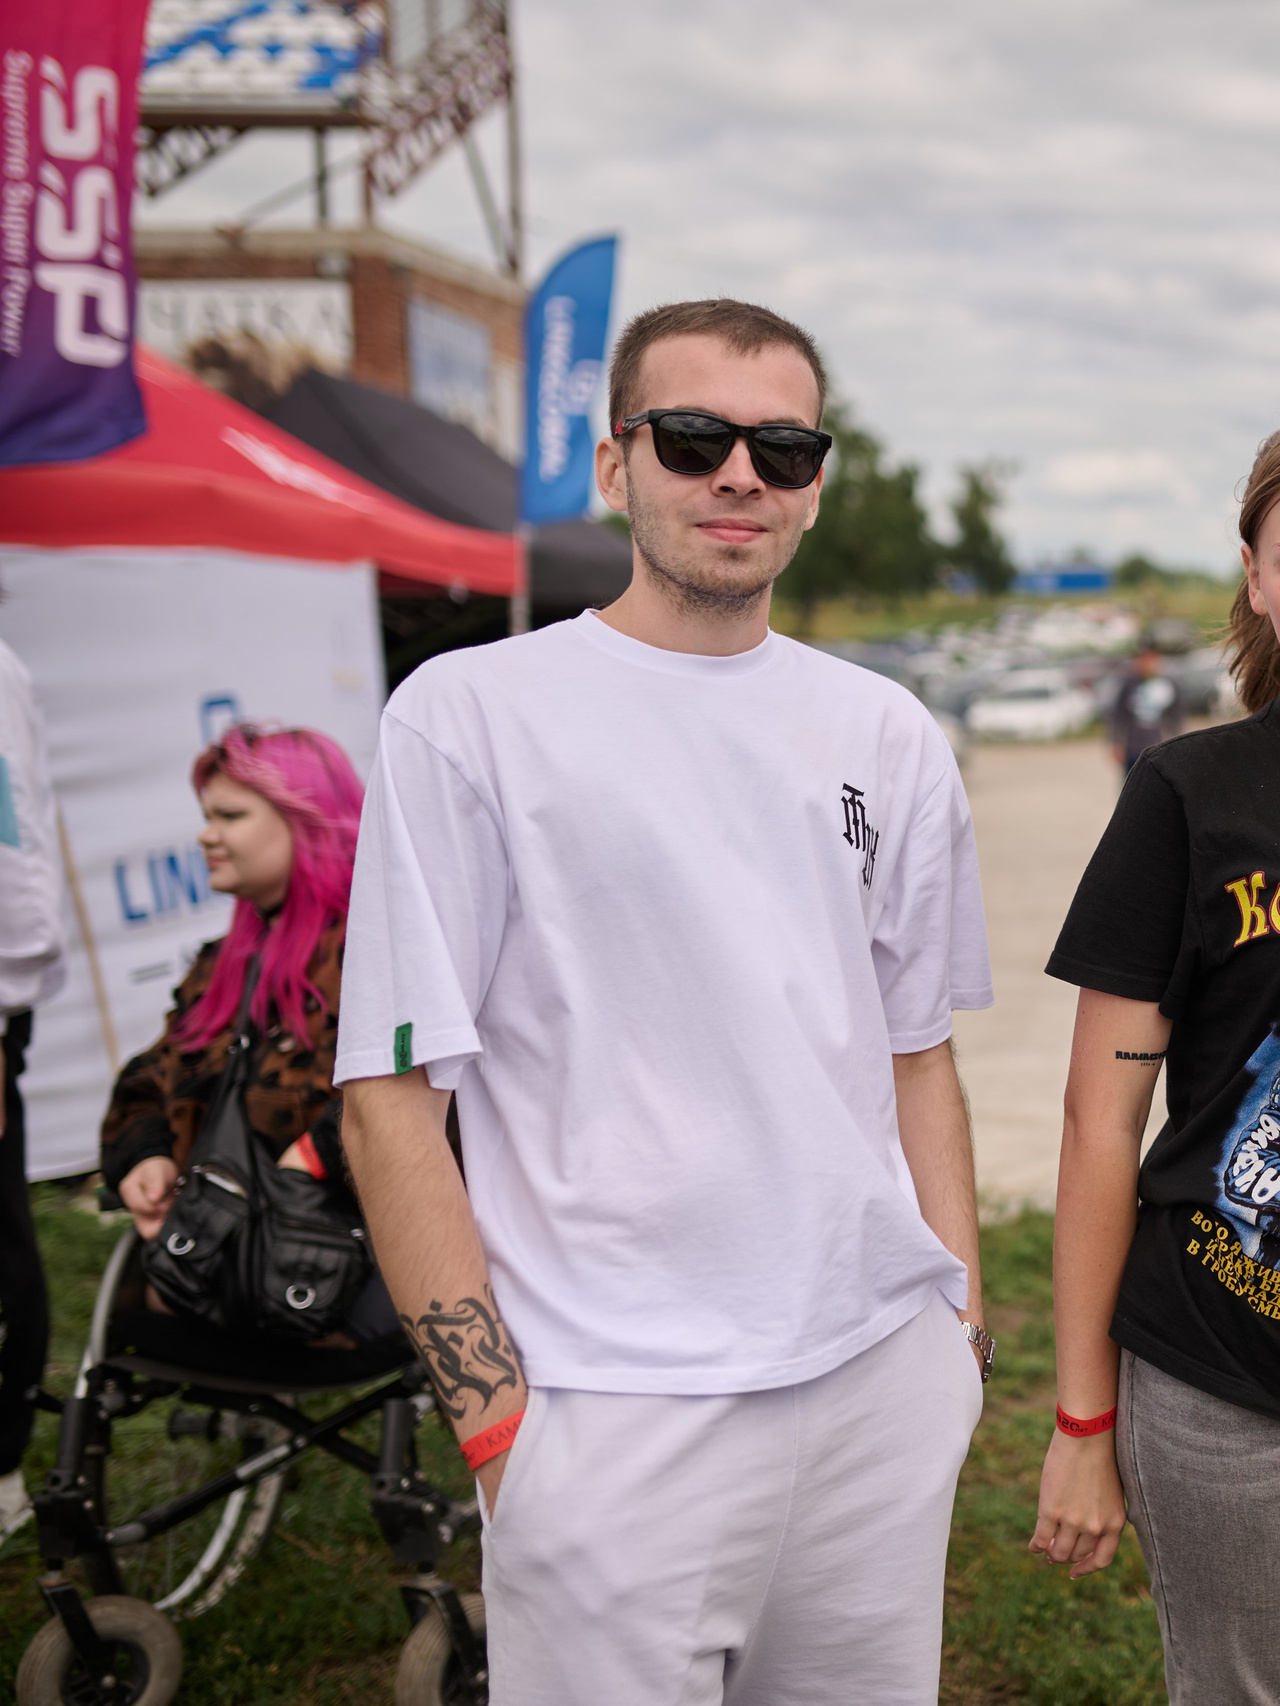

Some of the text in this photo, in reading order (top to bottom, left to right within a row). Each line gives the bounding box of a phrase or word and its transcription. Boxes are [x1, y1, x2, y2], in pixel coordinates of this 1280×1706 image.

[0, 49, 34, 179] Supreme
[0, 181, 31, 264] Super
[34, 54, 130, 368] SSP
[113, 843, 207, 925] LIN
[1186, 1239, 1201, 1255] В
[1201, 1252, 1246, 1297] ГРОБУ
[1191, 1210, 1213, 1233] ВО
[1215, 1238, 1255, 1283] РАКЕ
